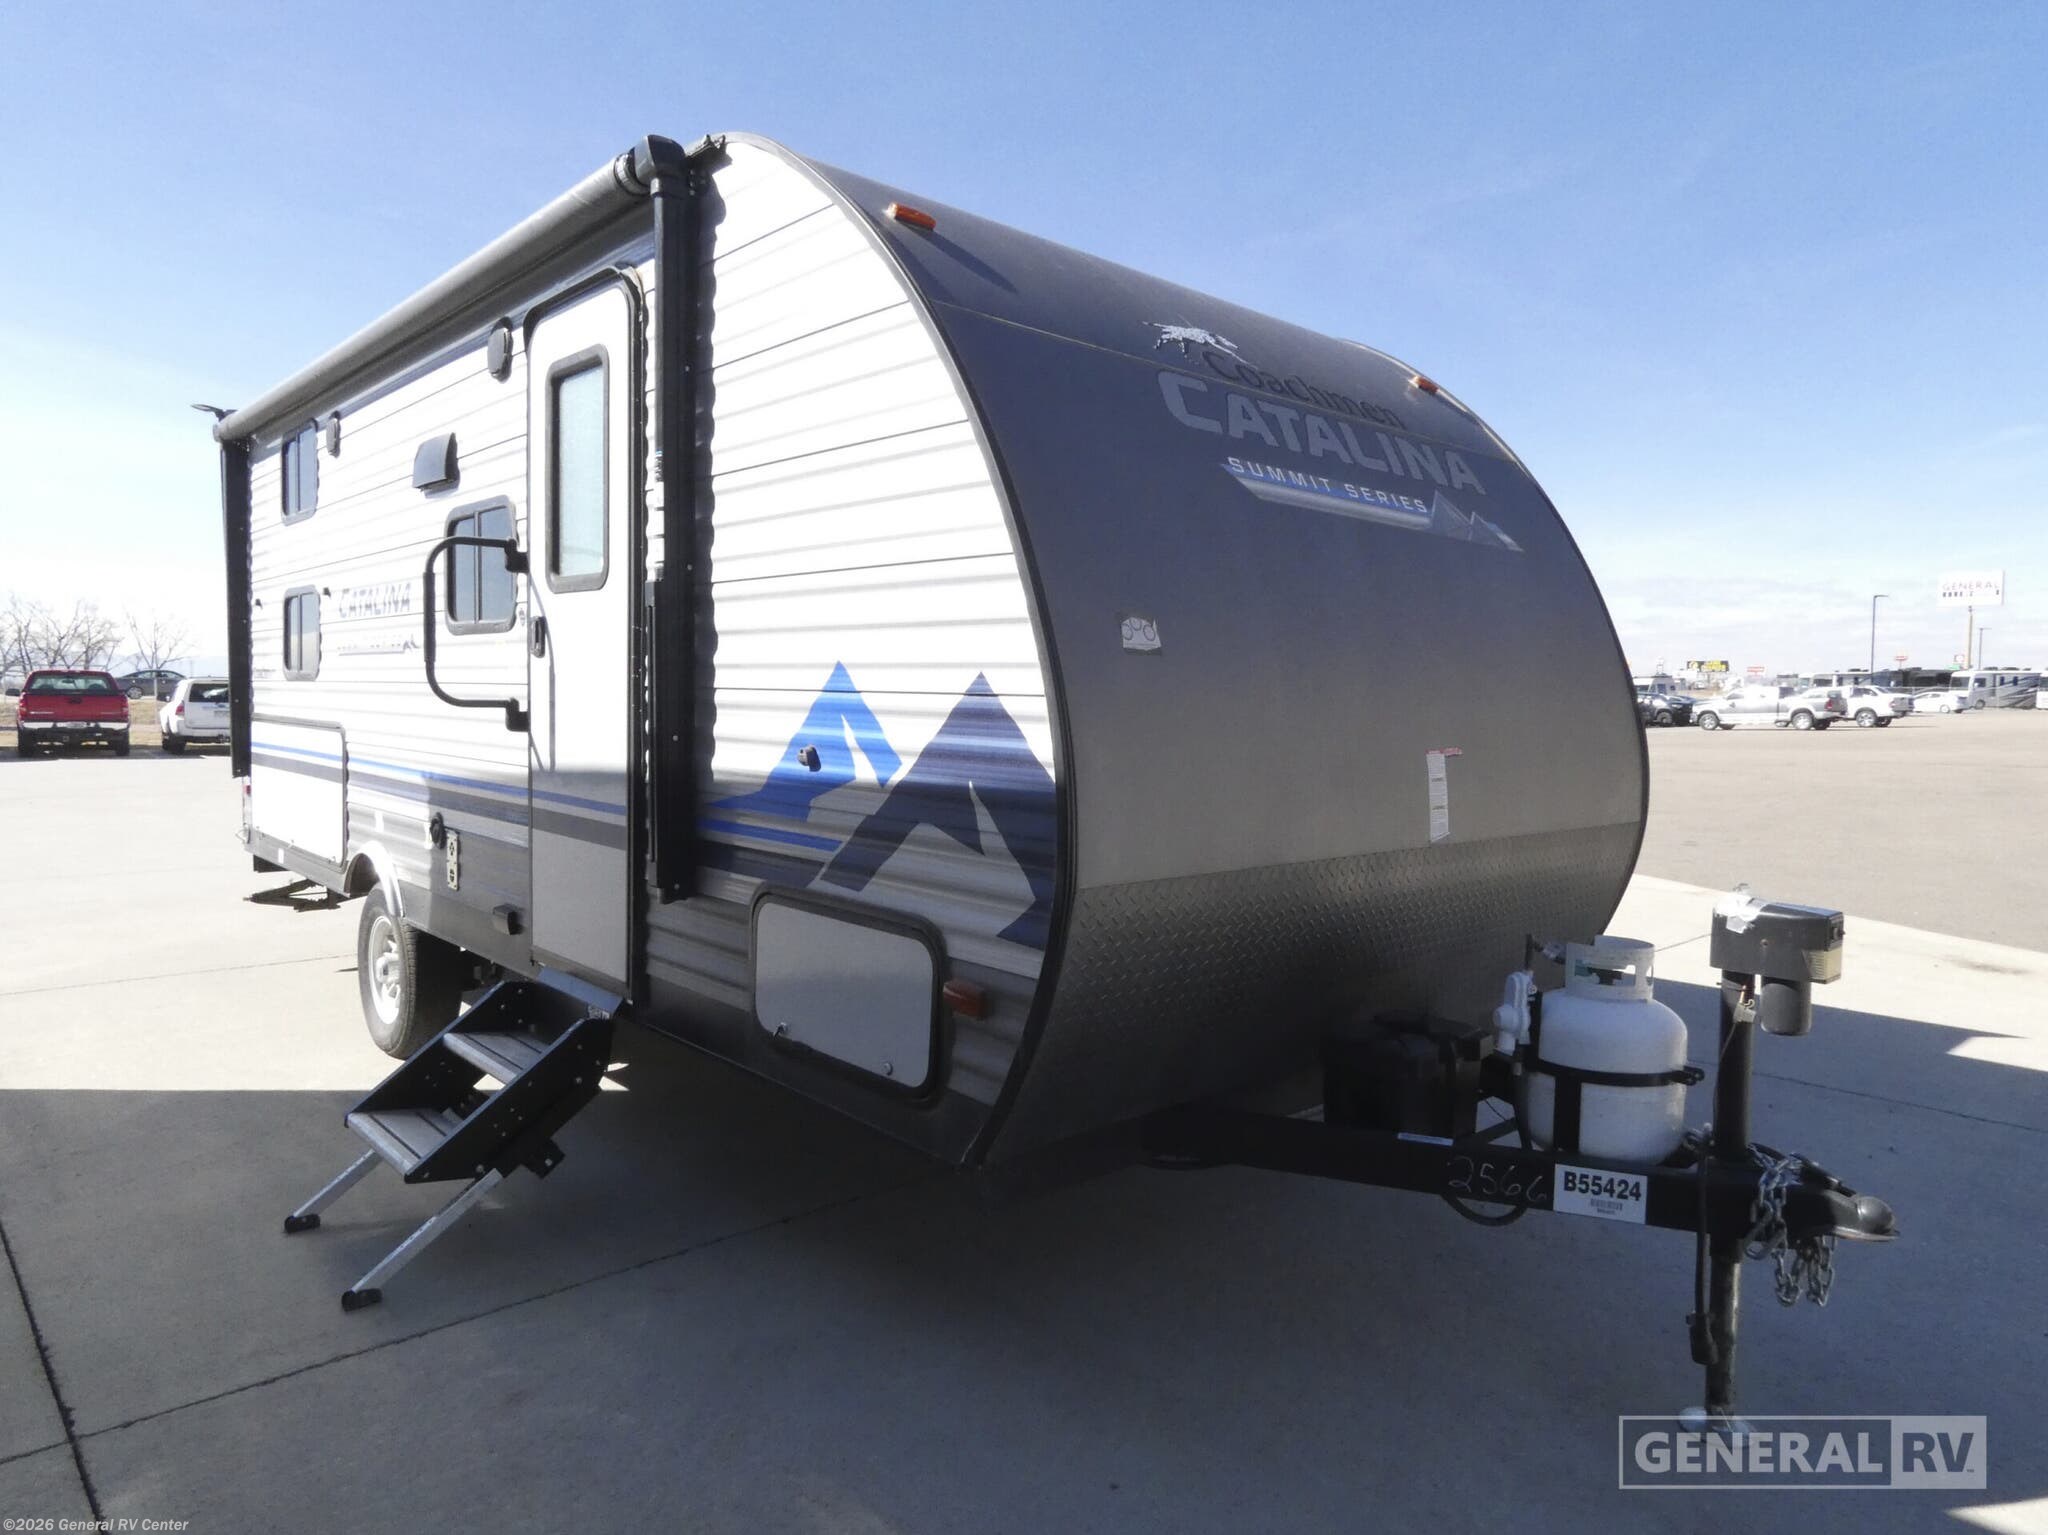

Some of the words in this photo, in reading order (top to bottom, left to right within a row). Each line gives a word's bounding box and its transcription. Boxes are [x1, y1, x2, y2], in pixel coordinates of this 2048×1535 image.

[1203, 351, 1406, 429] Coachmen
[1157, 370, 1486, 495] CATALINA
[1227, 456, 1332, 493] SUMMIT
[1344, 482, 1428, 514] SERIES
[338, 582, 411, 618] CATALINA
[1563, 1170, 1641, 1202] B55424
